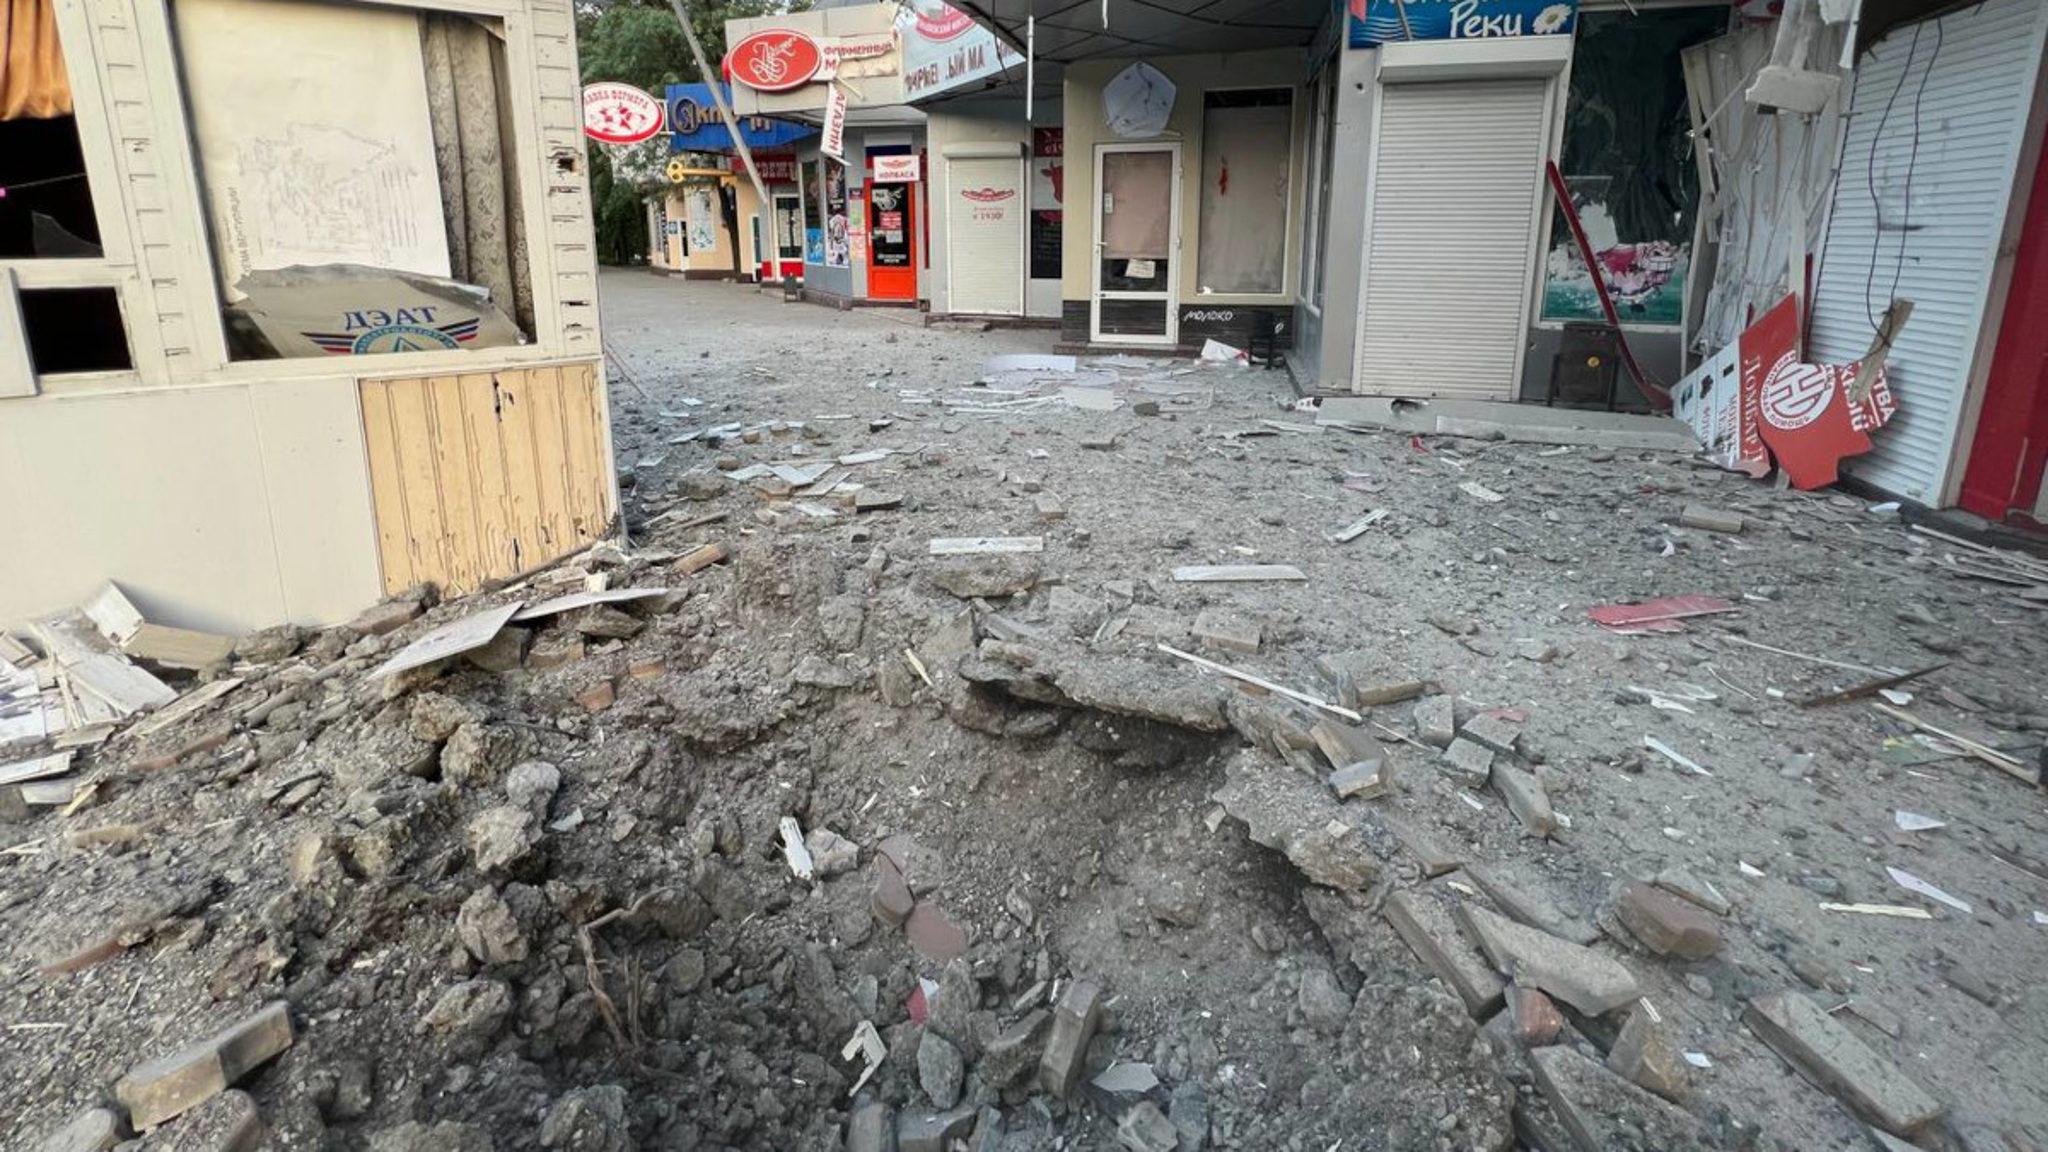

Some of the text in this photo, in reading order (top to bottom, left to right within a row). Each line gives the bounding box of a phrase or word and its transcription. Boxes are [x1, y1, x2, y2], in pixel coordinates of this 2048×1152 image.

[1450, 0, 1523, 38] Реки
[344, 306, 437, 331] ДЭАТ
[1744, 355, 1764, 463] ЛОМБАРД
